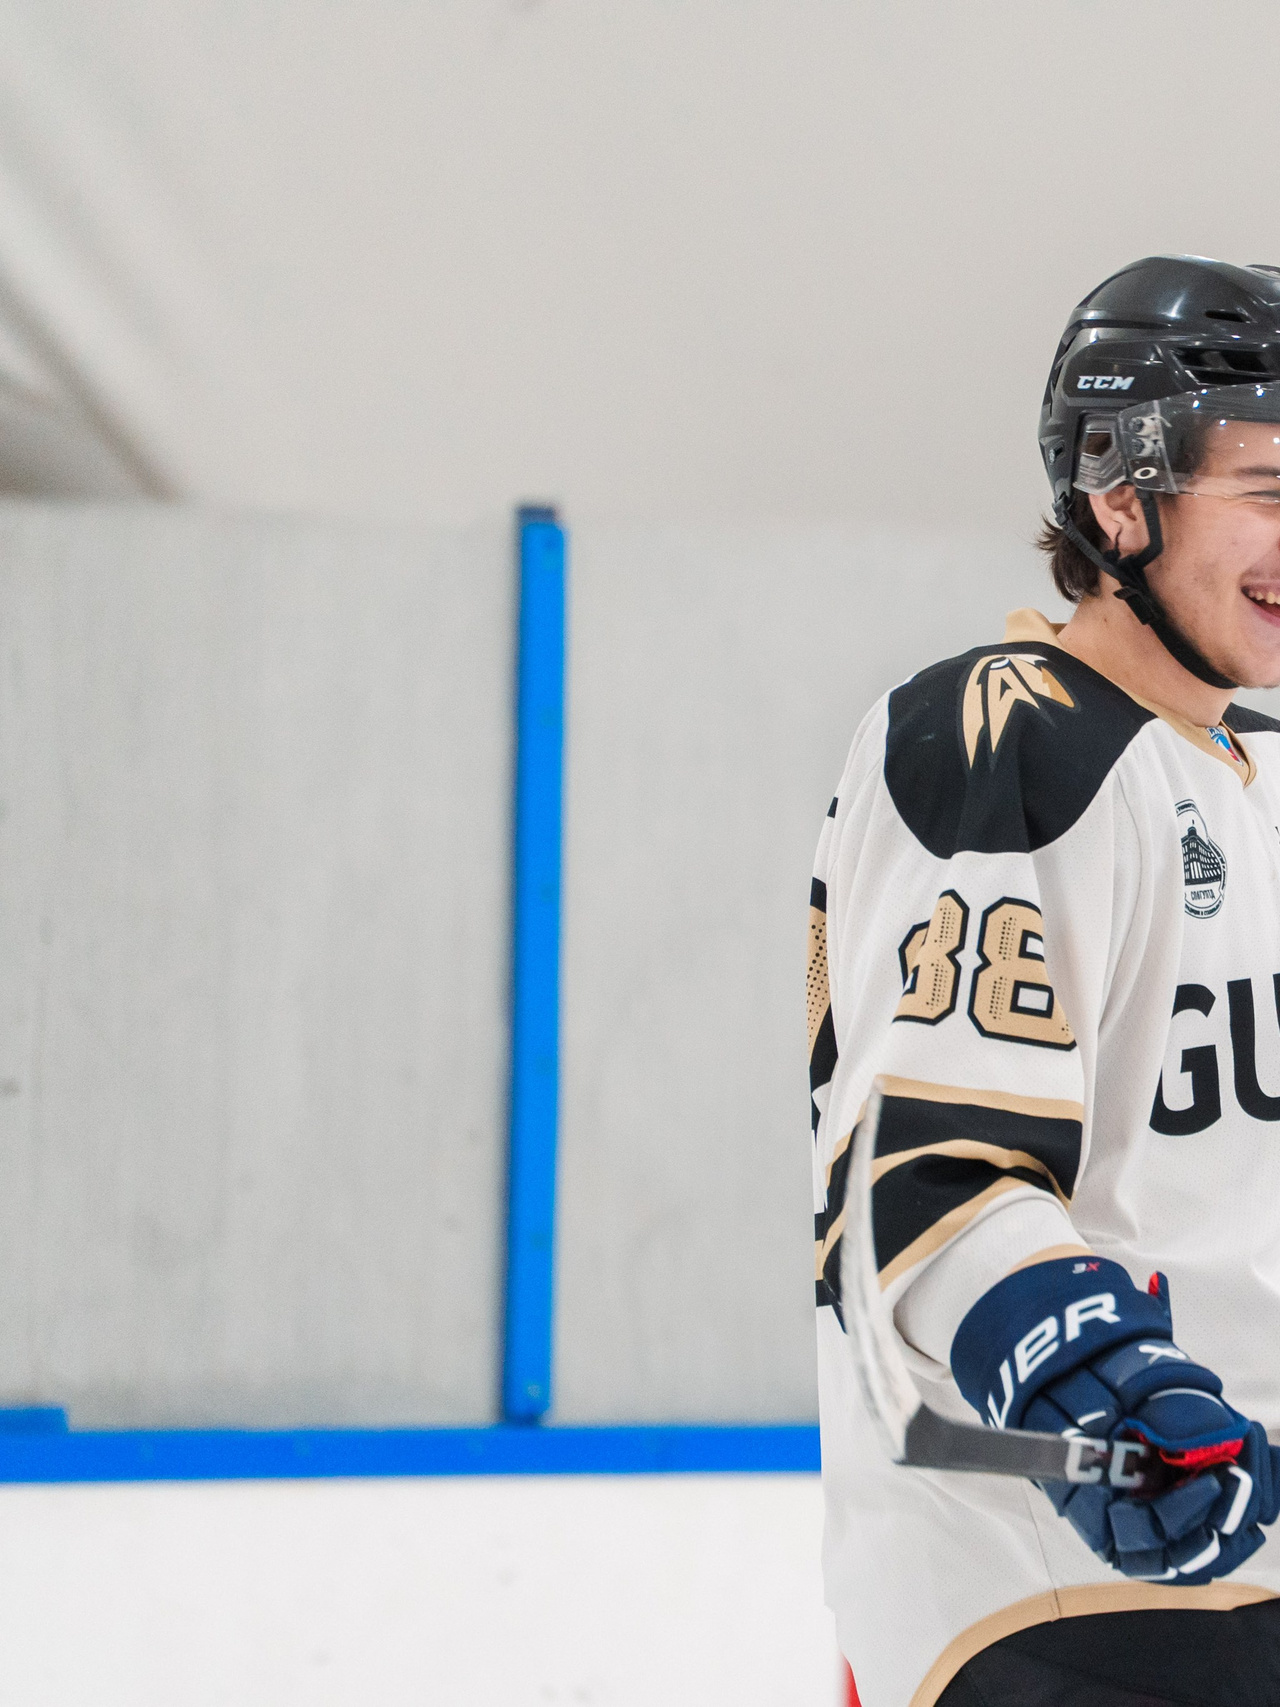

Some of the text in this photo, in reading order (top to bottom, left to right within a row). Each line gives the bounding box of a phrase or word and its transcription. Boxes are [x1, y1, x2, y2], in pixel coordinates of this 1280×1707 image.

[1077, 375, 1135, 391] CCM
[892, 888, 1078, 1052] 88
[987, 1292, 1121, 1430] UER
[1064, 1435, 1148, 1488] CC
